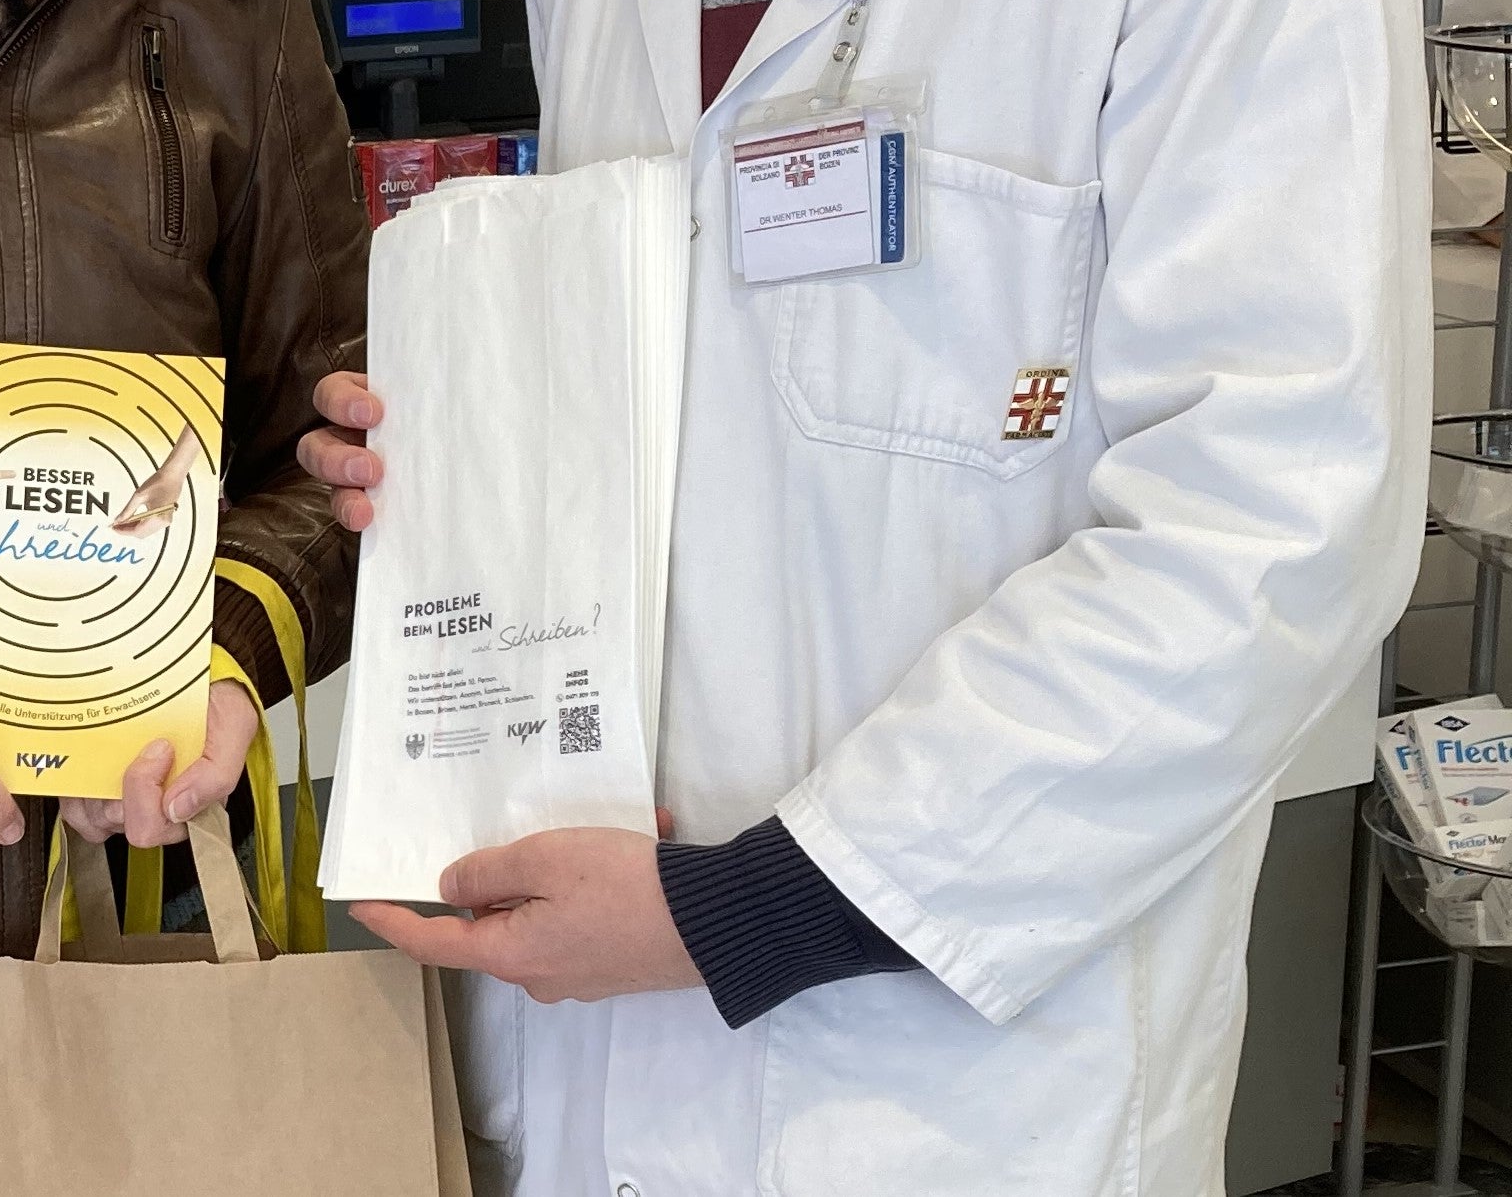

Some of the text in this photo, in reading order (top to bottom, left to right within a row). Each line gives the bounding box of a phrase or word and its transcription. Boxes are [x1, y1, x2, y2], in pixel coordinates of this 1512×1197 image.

[395, 45, 419, 54] EPSON
[379, 177, 418, 194] durex
[751, 171, 780, 182] BOLZANO
[772, 209, 807, 224] WENTER
[809, 204, 843, 216] THOMAS
[887, 167, 898, 252] AUTHENTICATOR
[1026, 369, 1066, 378] ORDINE
[23, 467, 96, 486] BESSER
[5, 485, 112, 518] LESEN
[37, 518, 70, 533] und
[404, 592, 481, 619] PROBLEME
[403, 612, 493, 638] BEIM LESEN
[15, 707, 84, 722] Unterstützung
[87, 708, 101, 719] für
[104, 688, 161, 715] Erwachsene
[1436, 739, 1512, 764] Flect
